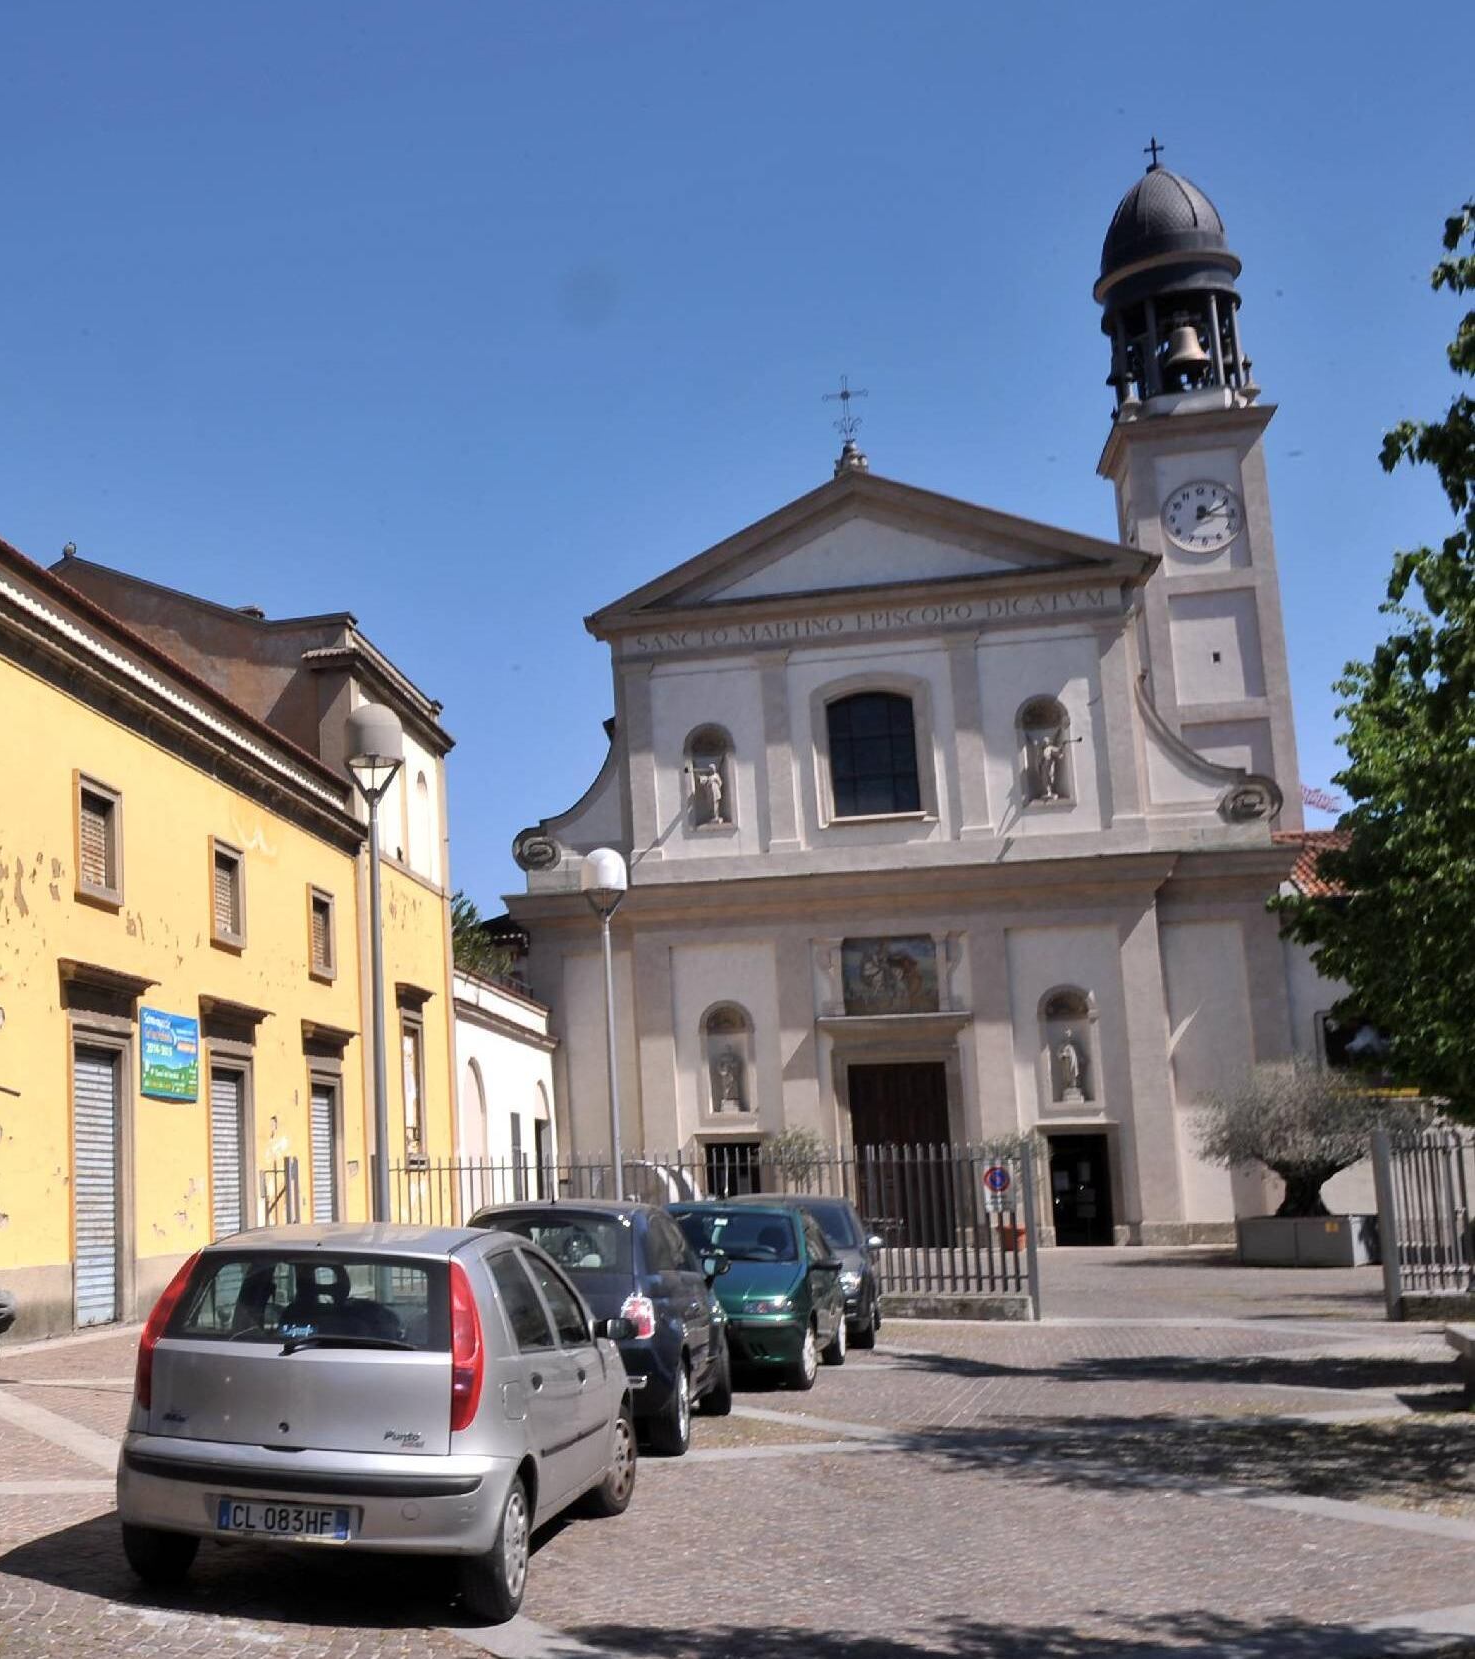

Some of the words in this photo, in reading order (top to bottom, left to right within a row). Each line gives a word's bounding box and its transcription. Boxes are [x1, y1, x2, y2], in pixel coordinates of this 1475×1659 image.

[636, 628, 729, 651] SANCTO
[738, 618, 844, 642] MARTINO
[856, 603, 973, 630] EPISCOPO
[233, 1504, 256, 1529] CL
[264, 1507, 333, 1535] 083HF
